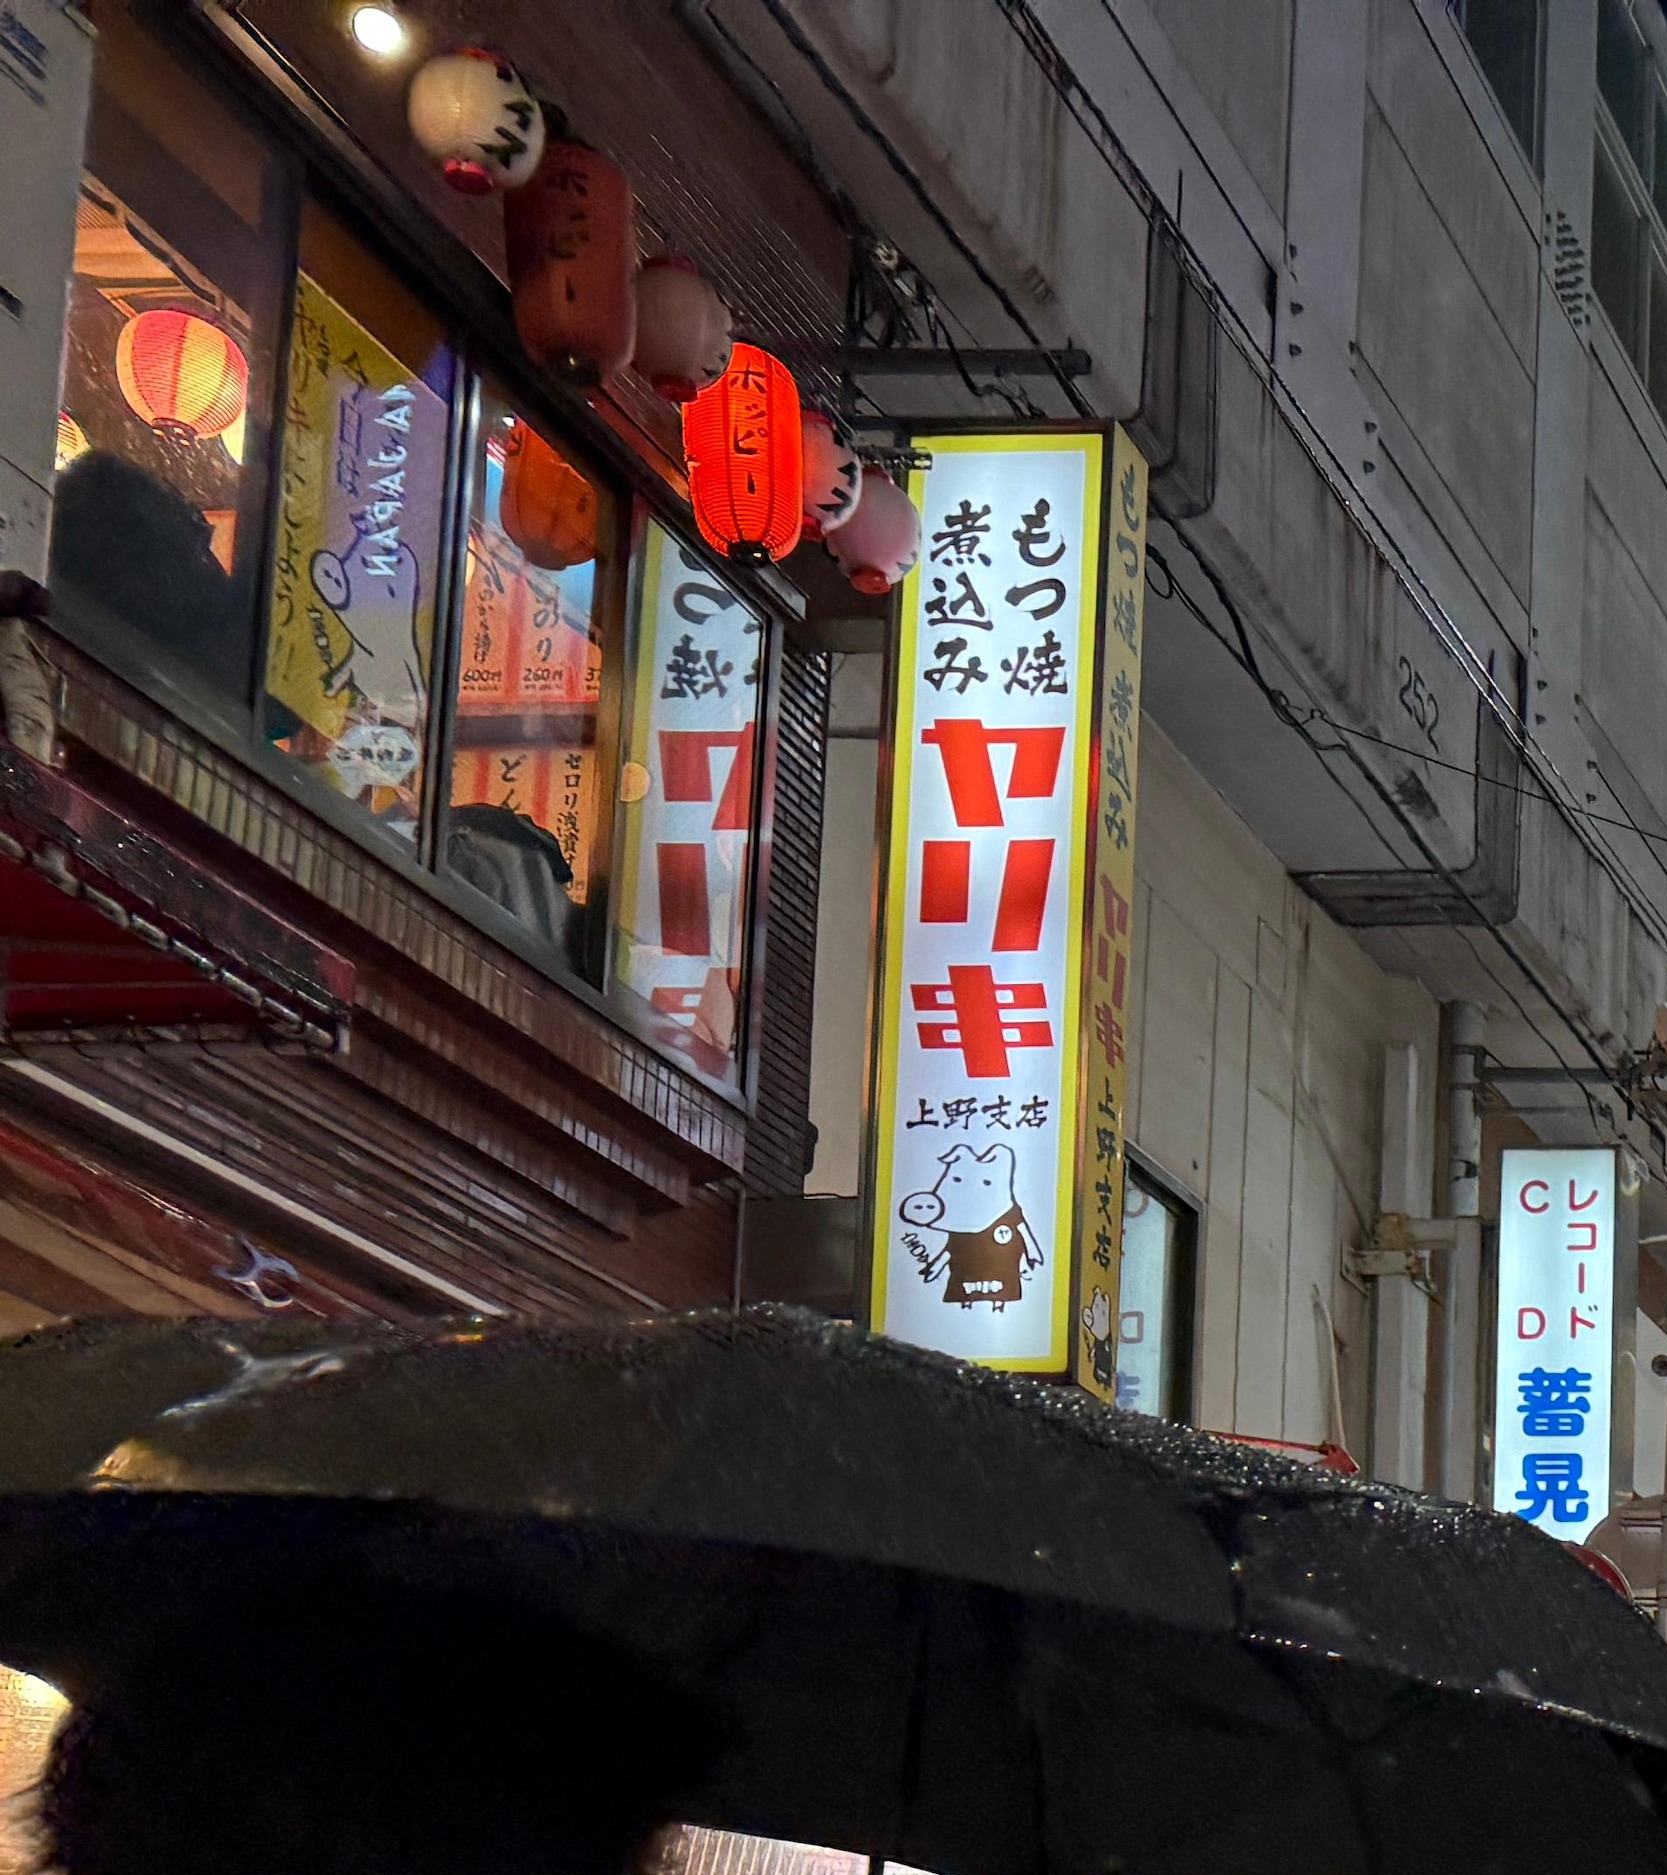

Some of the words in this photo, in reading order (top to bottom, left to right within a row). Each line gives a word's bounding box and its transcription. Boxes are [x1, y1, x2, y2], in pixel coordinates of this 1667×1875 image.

[727, 364, 769, 494] ホッピー
[923, 499, 995, 695] 煮込み
[1000, 497, 1068, 696] もつ焼
[909, 718, 1067, 1079] ヤリキ
[905, 1094, 1049, 1130] 上野支店
[1567, 1180, 1598, 1340] レコード
[1514, 1367, 1592, 1524] 蓄晃
